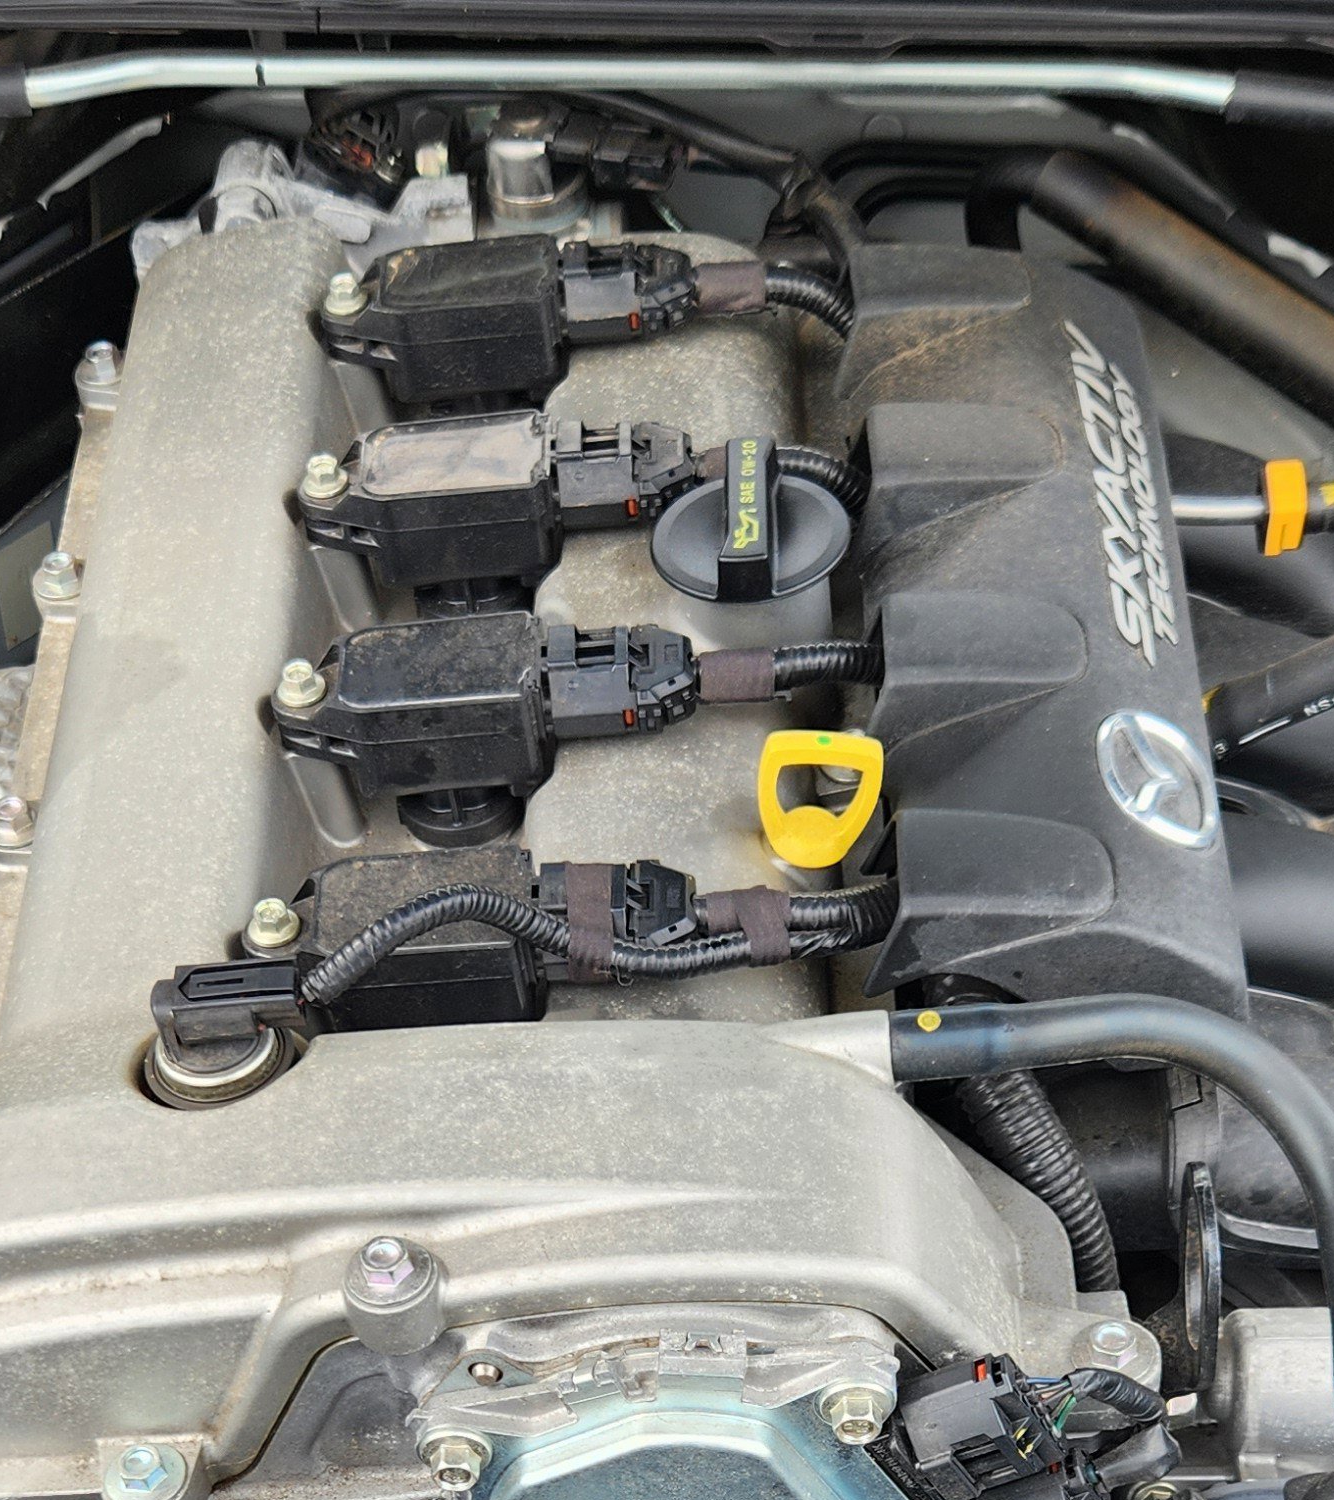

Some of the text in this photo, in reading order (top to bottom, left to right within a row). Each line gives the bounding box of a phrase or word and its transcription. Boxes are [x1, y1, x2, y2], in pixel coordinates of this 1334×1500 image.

[740, 481, 755, 504] SAE
[1064, 320, 1156, 666] SKYACTIV
[1109, 362, 1178, 646] TECHNOLOGY
